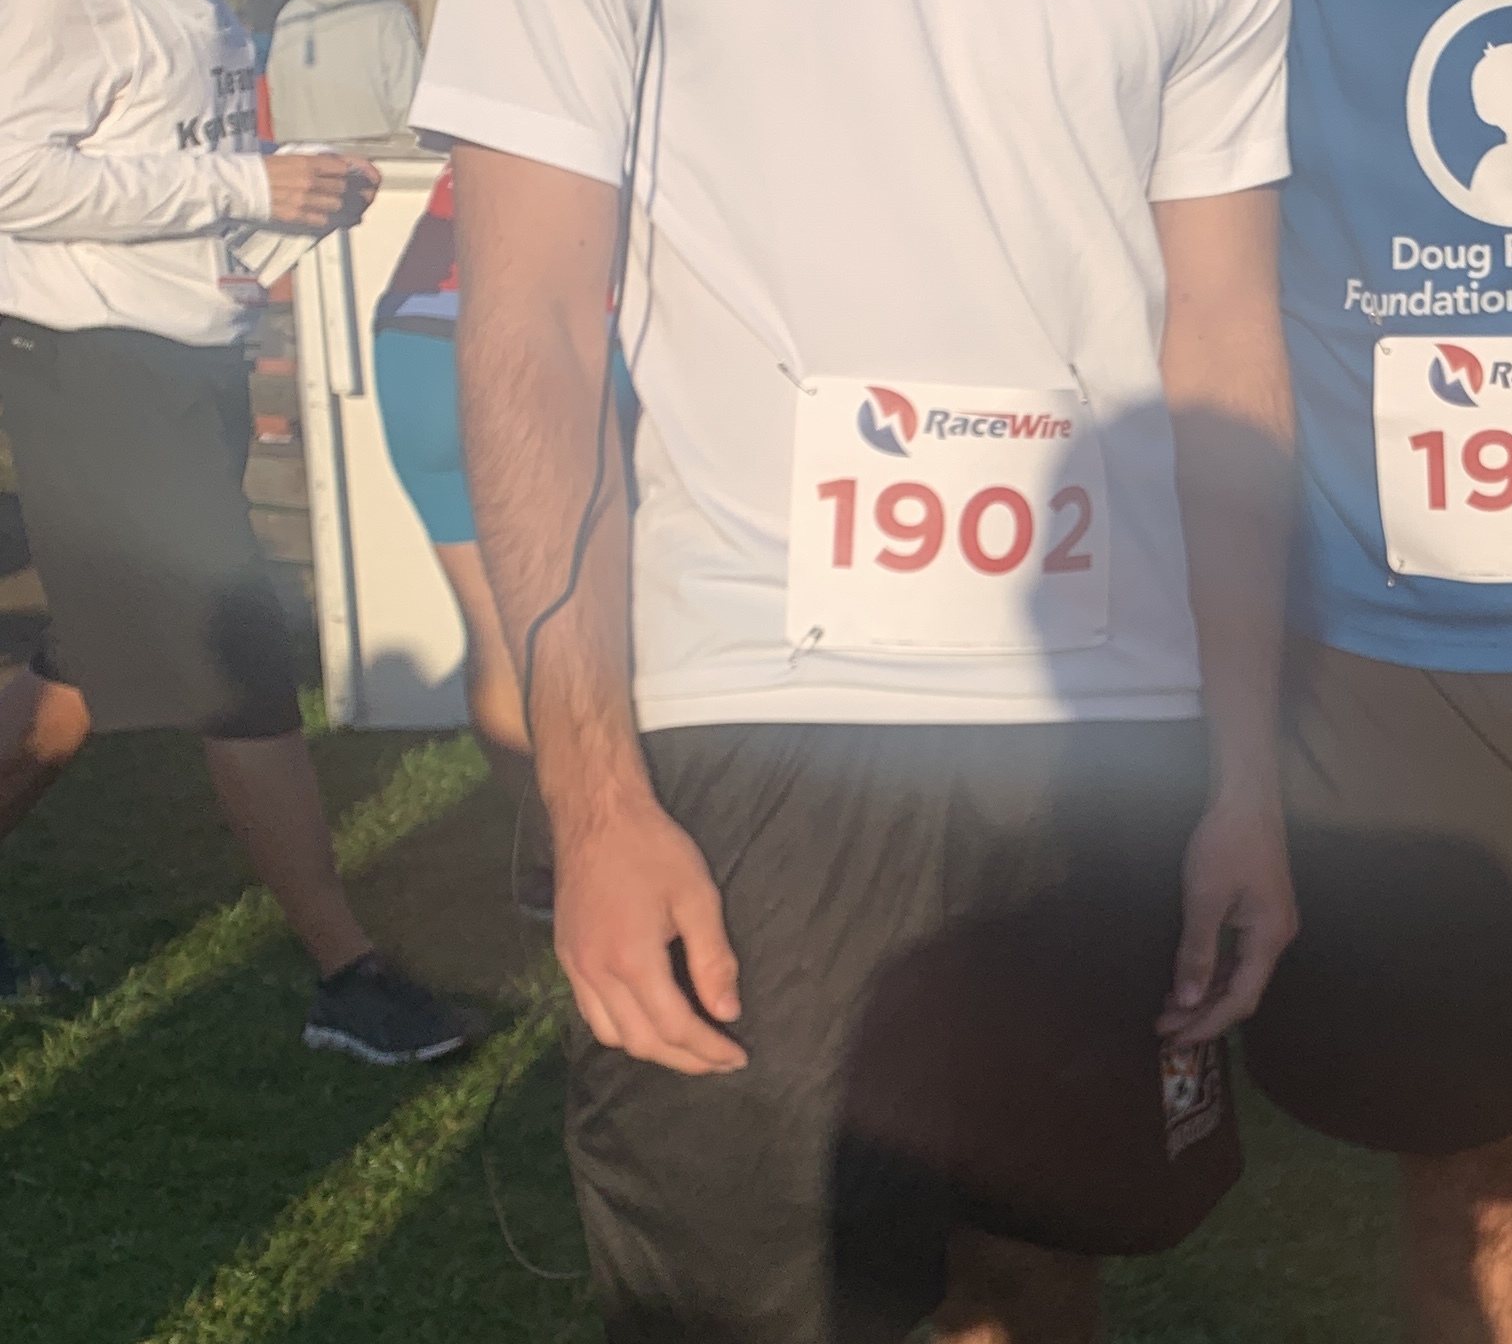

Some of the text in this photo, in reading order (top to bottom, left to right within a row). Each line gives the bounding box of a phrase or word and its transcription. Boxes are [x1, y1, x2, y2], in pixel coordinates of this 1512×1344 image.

[1390, 235, 1492, 279] Doug
[923, 408, 1073, 441] RaceWire
[816, 477, 1094, 578] 1902
